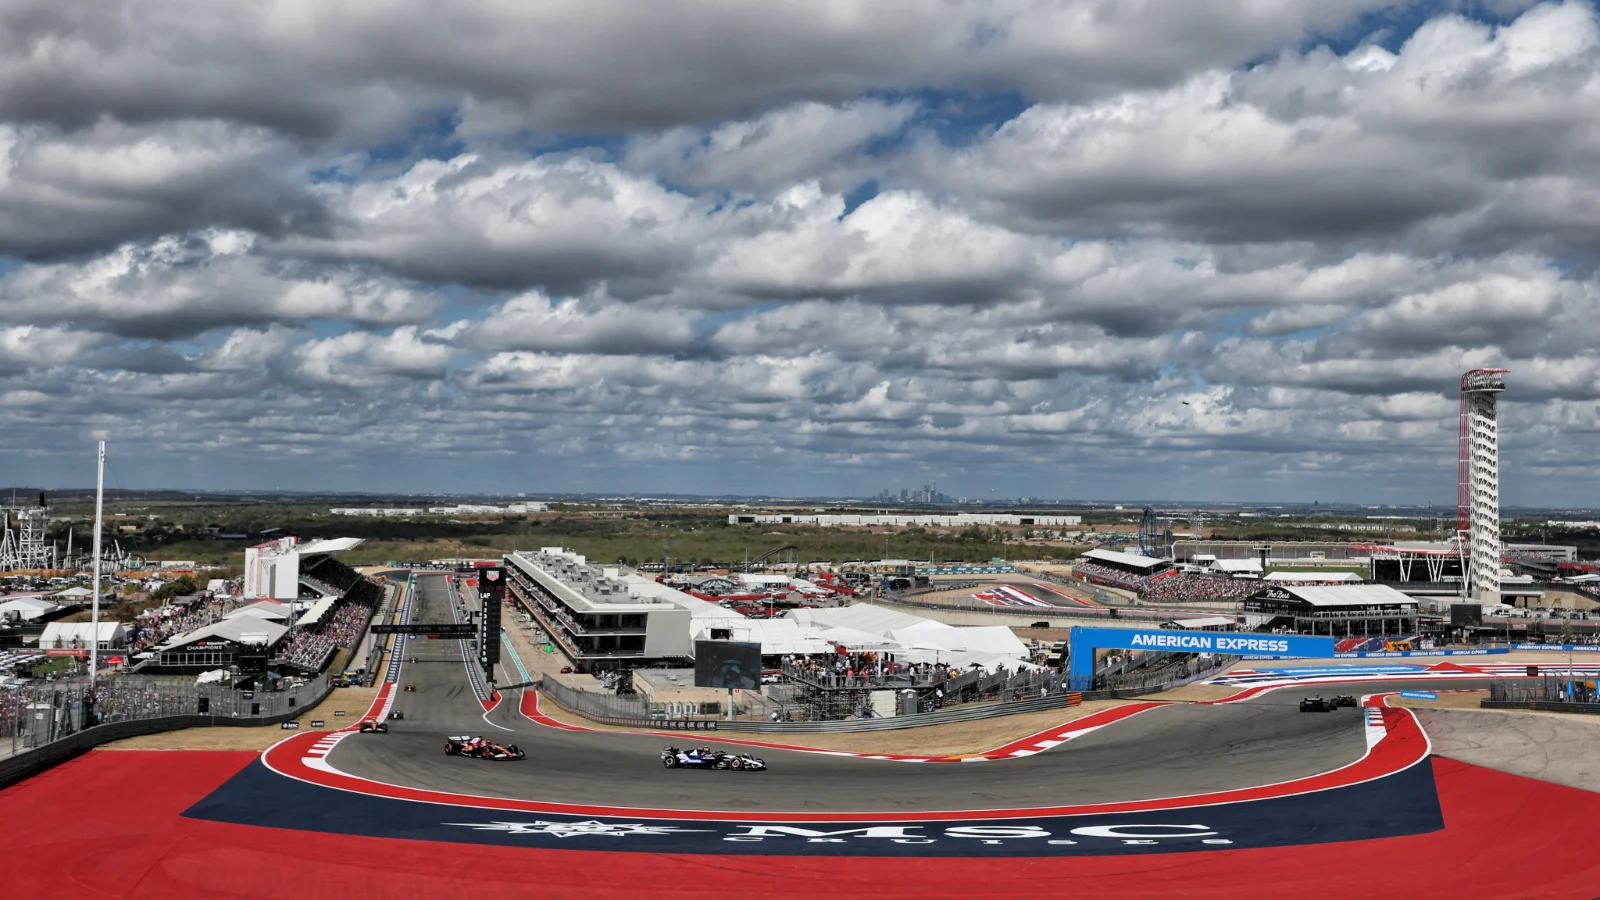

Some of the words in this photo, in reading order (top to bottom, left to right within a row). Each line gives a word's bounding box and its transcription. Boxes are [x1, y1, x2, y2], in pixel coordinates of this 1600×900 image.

[1131, 634, 1211, 649] AMERICAN
[1216, 637, 1288, 652] EXPRESS
[727, 824, 1219, 839] MSC
[723, 837, 1234, 845] CRUISES
